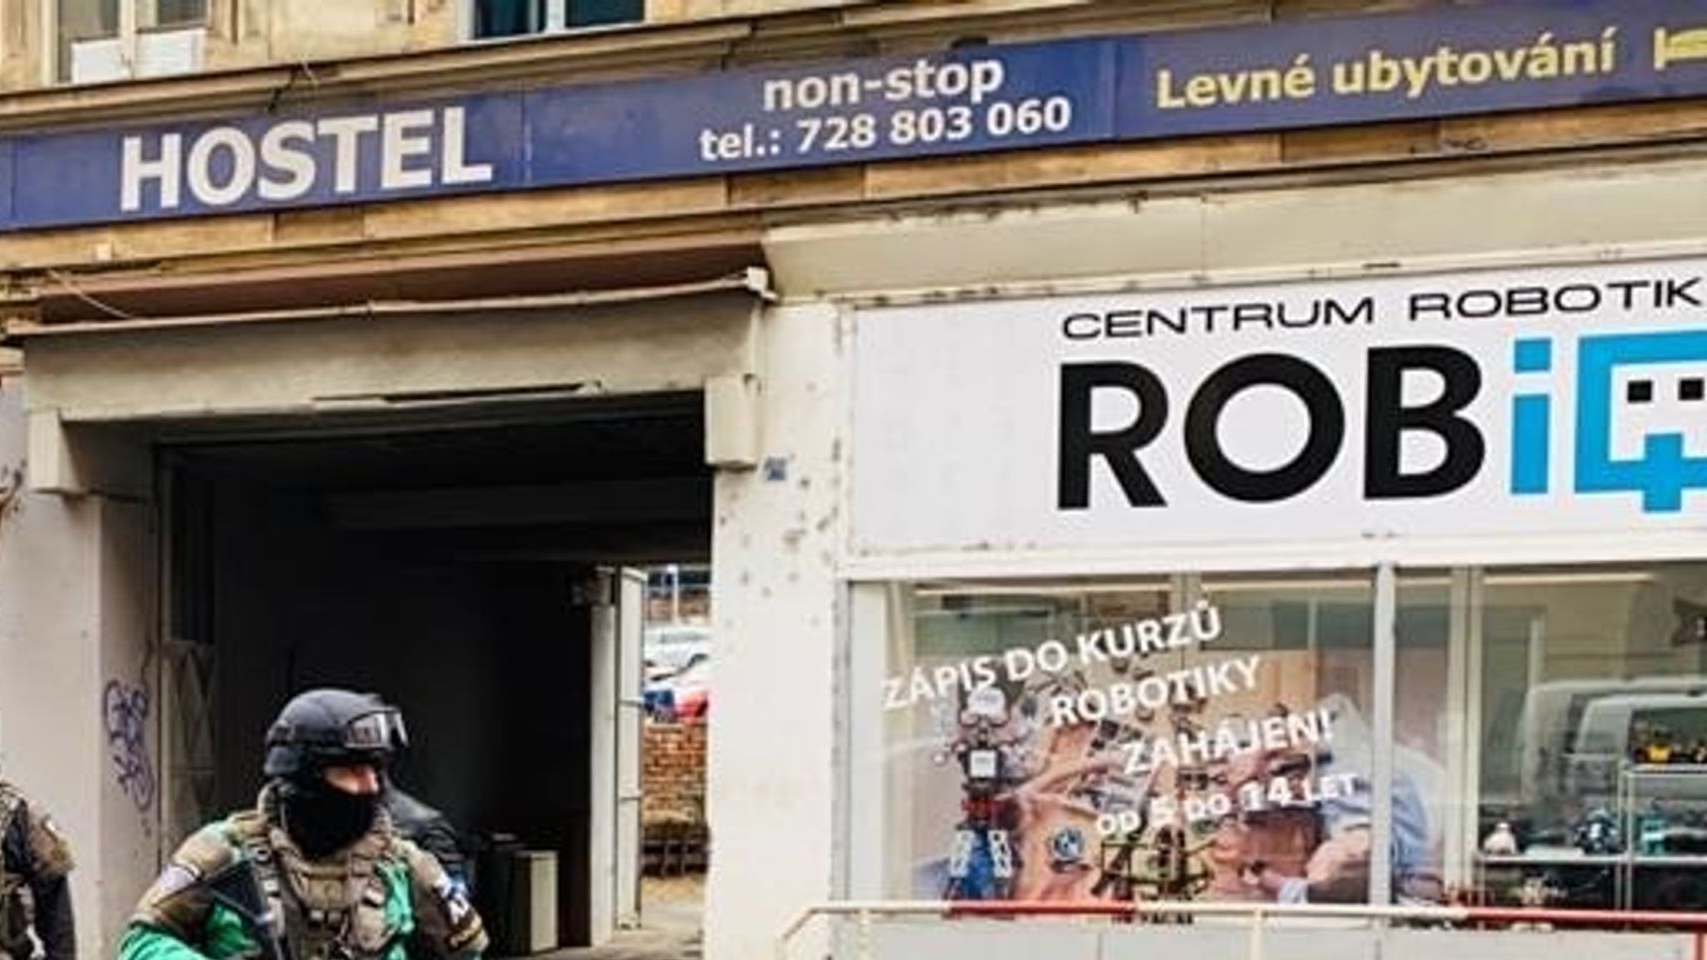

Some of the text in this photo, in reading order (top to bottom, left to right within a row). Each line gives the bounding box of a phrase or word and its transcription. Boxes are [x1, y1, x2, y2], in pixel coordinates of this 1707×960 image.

[762, 58, 1004, 112] non-stop
[1156, 27, 1618, 109] Levné ubytování
[120, 105, 493, 213] HOSTEL
[699, 96, 1072, 162] tel.: 728 803 060
[1061, 276, 1703, 340] CENTRUM ROBOTIK
[1005, 640, 1069, 683] DO
[1077, 599, 1222, 666] KURZŮ
[1050, 656, 1261, 729] ROBOTIKY
